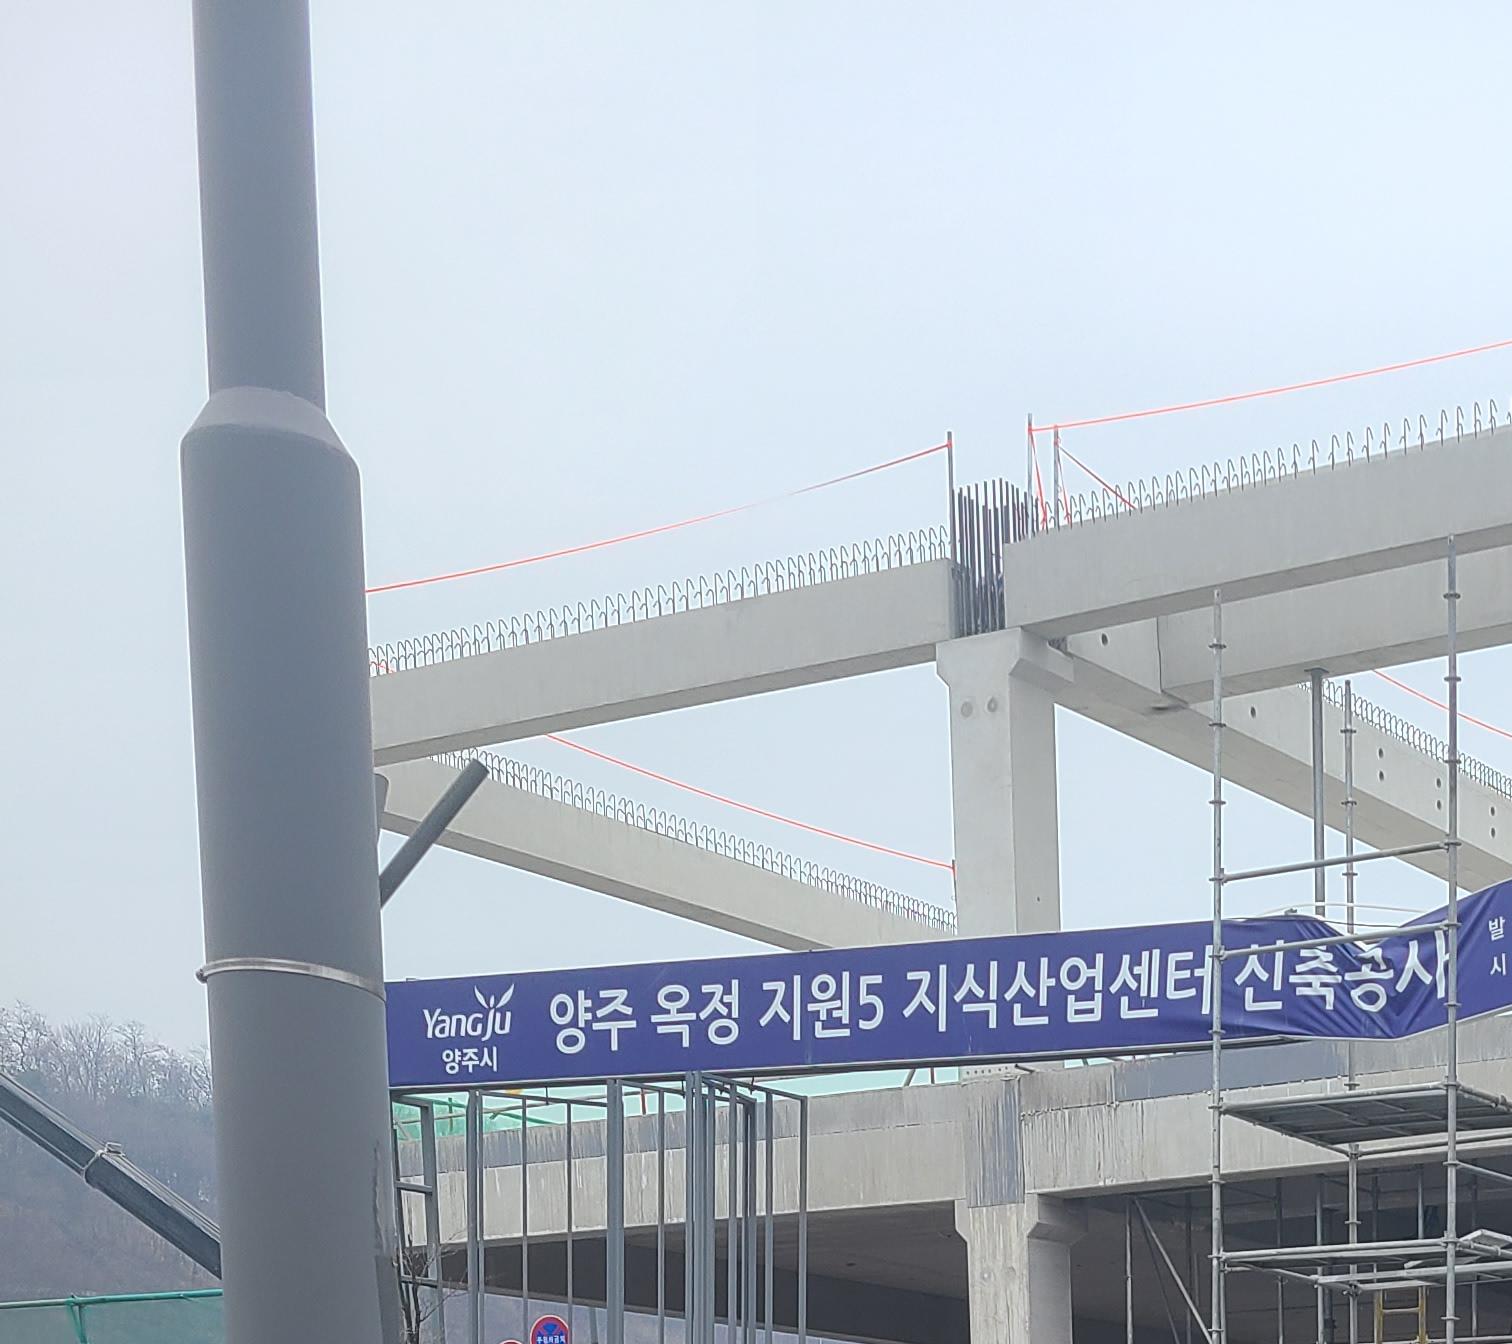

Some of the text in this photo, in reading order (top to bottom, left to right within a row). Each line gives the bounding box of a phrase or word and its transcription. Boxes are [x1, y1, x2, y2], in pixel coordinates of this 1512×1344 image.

[550, 930, 1449, 1054] 양주 옥정 지원5 지식산업센터 신축공사
[442, 1046, 498, 1074] 양주시
